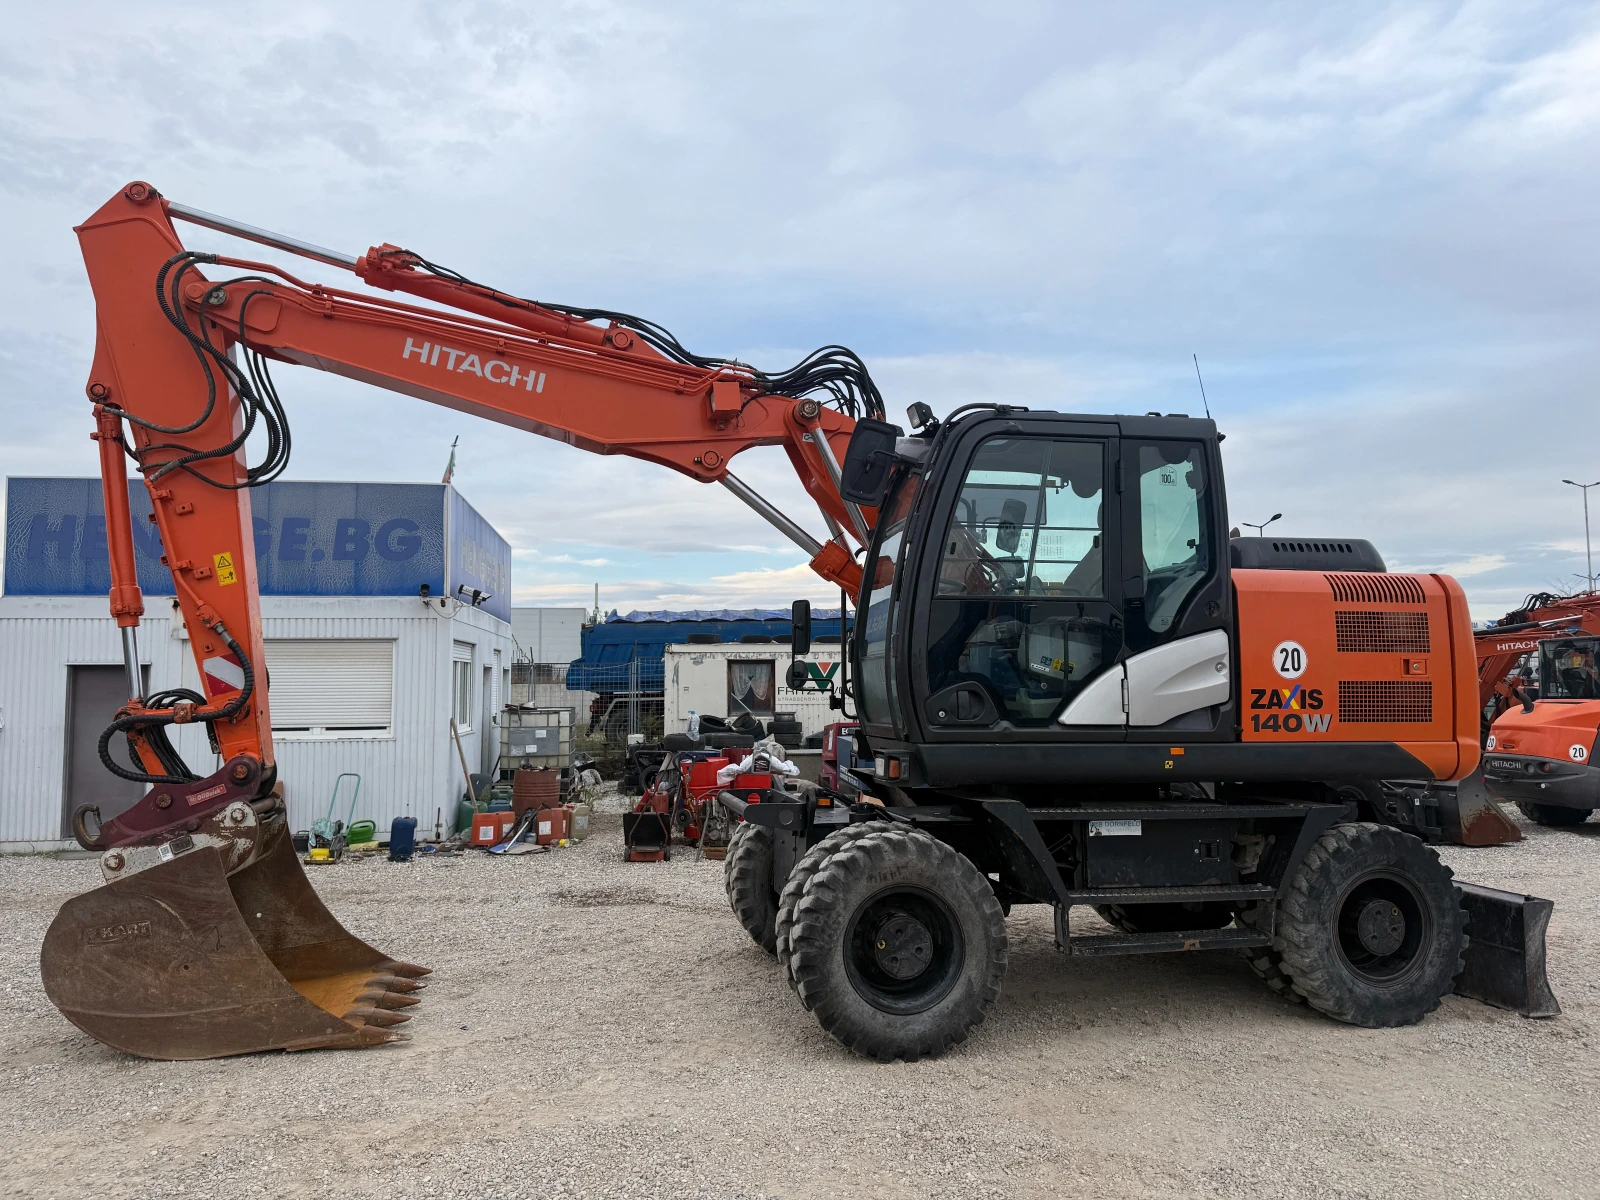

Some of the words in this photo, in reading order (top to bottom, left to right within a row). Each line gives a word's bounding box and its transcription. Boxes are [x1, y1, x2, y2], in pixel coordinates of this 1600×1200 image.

[402, 337, 546, 393] HITACHI
[27, 514, 422, 561] HENE.BG
[1496, 641, 1539, 651] HITACH
[1280, 648, 1301, 672] 20
[1251, 684, 1324, 710] ZAXIS
[1251, 713, 1332, 732] 140W
[1487, 738, 1495, 747] 20
[1573, 748, 1584, 758] 20
[1492, 760, 1521, 769] HITACHI
